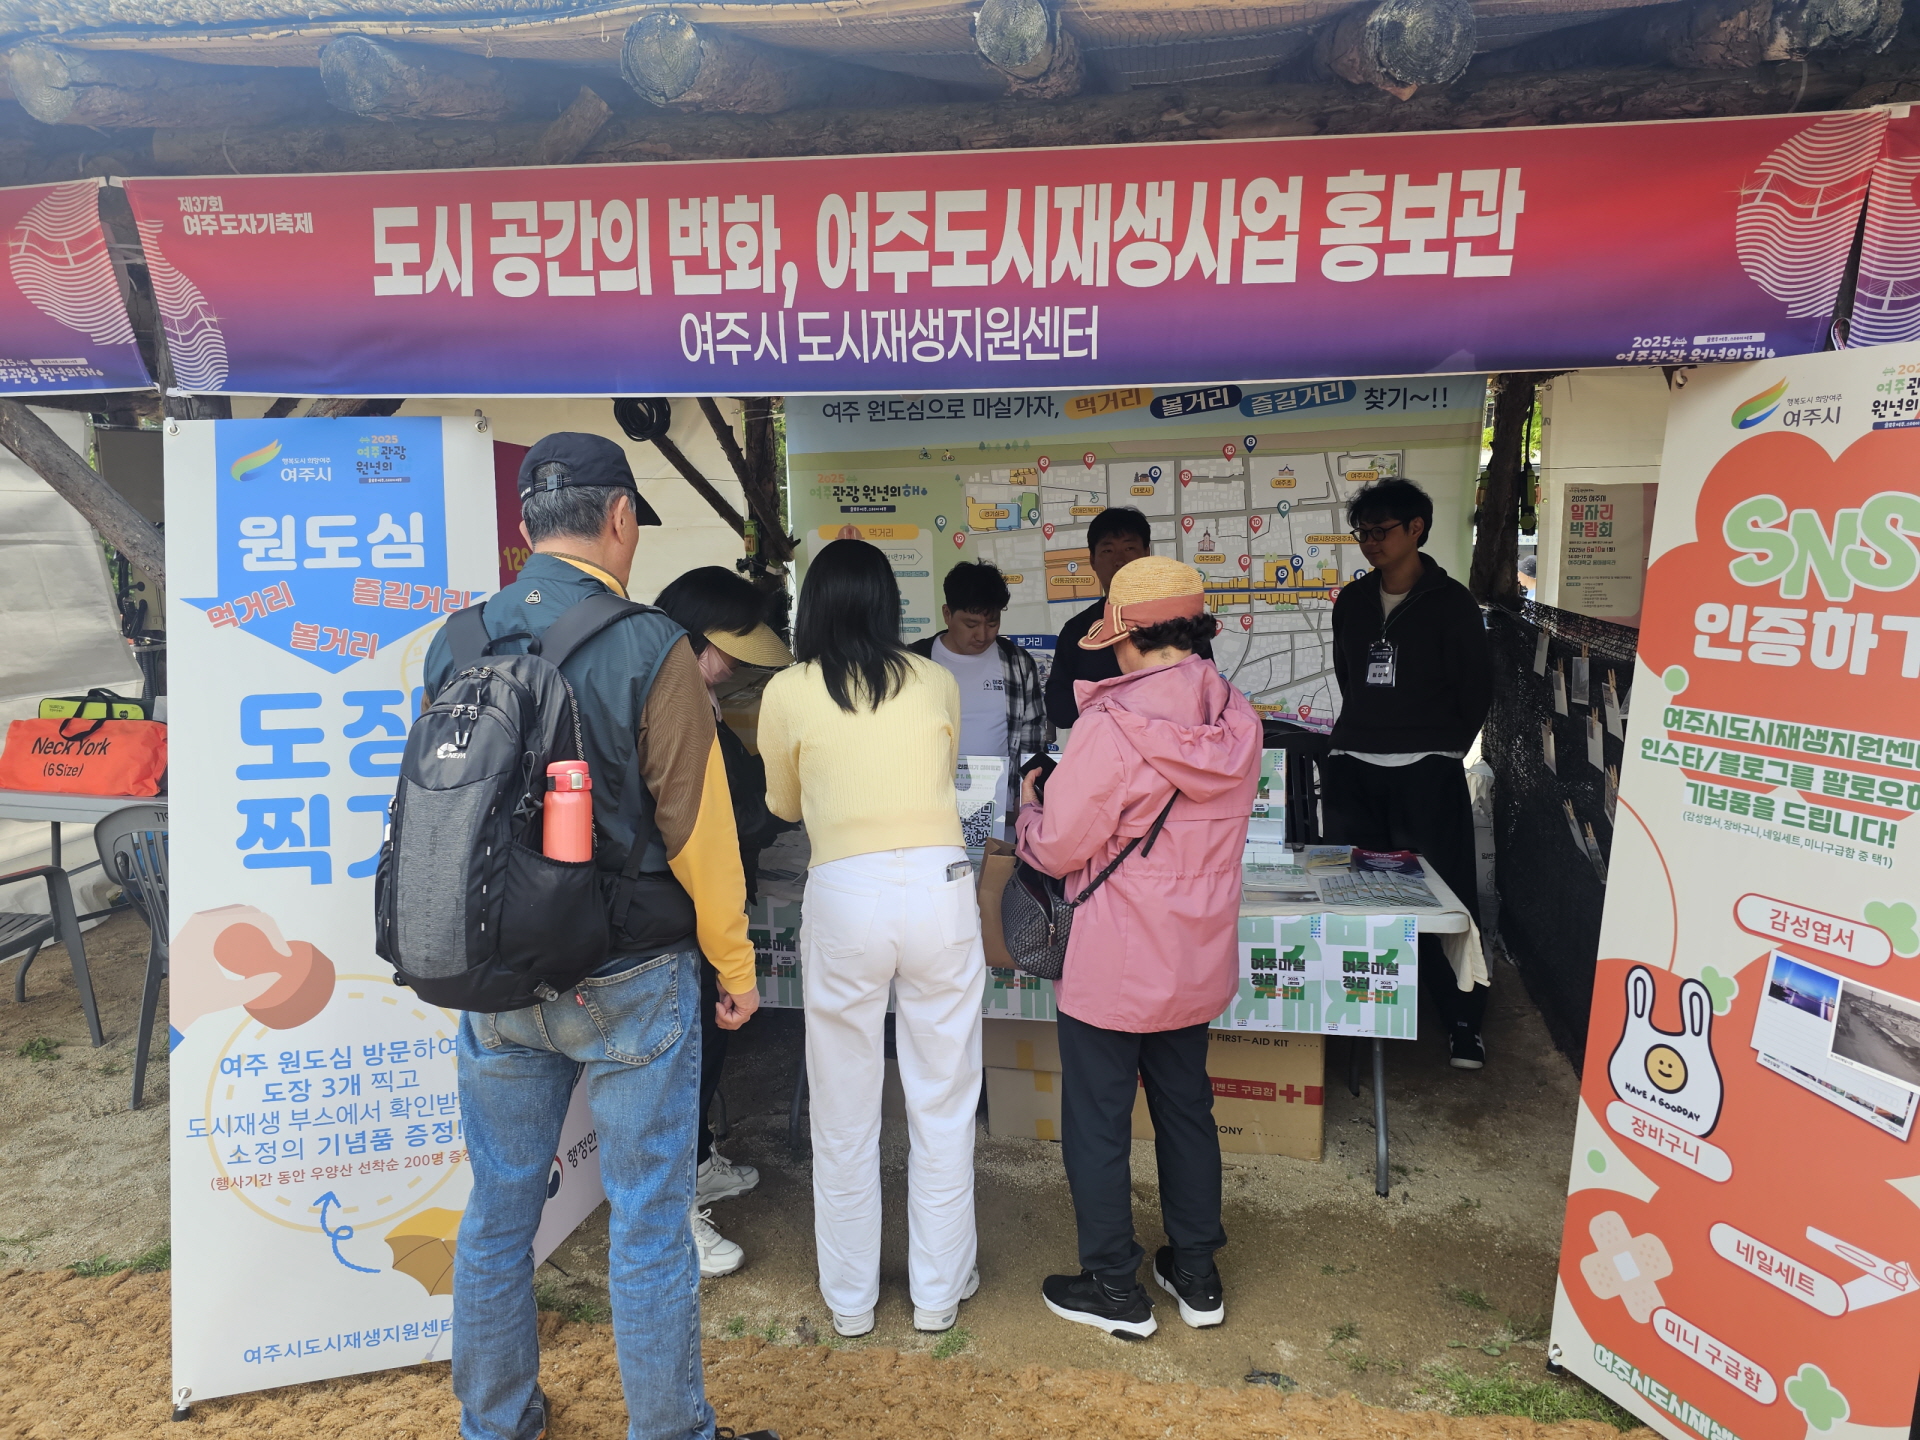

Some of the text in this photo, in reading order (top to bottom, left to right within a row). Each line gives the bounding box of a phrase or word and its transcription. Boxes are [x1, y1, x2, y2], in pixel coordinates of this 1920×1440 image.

[178, 196, 223, 213] 제37회
[183, 212, 313, 236] 여주도자기축제
[373, 167, 1525, 308] 도시 공간의 변화, 여주도시재생사업 홍보관
[680, 305, 1099, 365] 여주시 도시재생지원센터
[1632, 336, 1671, 348] 2025
[1616, 350, 1687, 363] 여주관광
[822, 402, 861, 423] 여주
[867, 398, 966, 422] 원도심으로
[973, 395, 1059, 420] 마실가자,
[1074, 387, 1141, 415] 먹거리
[1161, 386, 1230, 418] 볼거리
[1251, 381, 1346, 415] 즐길거리
[1782, 406, 1842, 427] 여주시
[371, 435, 398, 444] 2025
[356, 446, 407, 460] 여주관광
[280, 467, 332, 482] 여주시
[817, 474, 846, 483] 2025
[810, 485, 860, 503] 여주관광
[1571, 495, 1588, 503] 2025
[1571, 504, 1613, 520] 일자리
[869, 528, 894, 538] 먹거리
[1570, 522, 1613, 537] 박람회
[238, 512, 425, 571] 원도심
[1722, 491, 1920, 602] SNS
[206, 581, 296, 629] 먹거리
[353, 577, 472, 614] 즐길거리
[290, 621, 379, 660] 볼거리
[1017, 637, 1043, 647] 볼거리
[31, 737, 111, 756] Neck York
[1685, 782, 1898, 850] 기념품을 드립니다!
[1858, 849, 1869, 862] 중
[1871, 852, 1894, 869] 택1)
[1769, 907, 1855, 953] 감성엽서
[1251, 958, 1306, 972] 여주마실
[1342, 961, 1399, 976] 여주마실
[1251, 973, 1278, 987] 장터
[1342, 976, 1370, 990] 장터
[1274, 1039, 1290, 1047] KIT
[220, 1034, 459, 1078] 여주 원도심 방문하여
[262, 1069, 420, 1103] 도장 3개 찍고
[1241, 1085, 1275, 1097] 구급함
[1625, 1082, 1647, 1099] HAVE
[1650, 1094, 1657, 1103] A
[186, 1110, 281, 1138] 도시재생
[288, 1099, 381, 1132] 부스에서
[1217, 1125, 1243, 1136] ONY
[1631, 1115, 1700, 1165] 장바구니
[227, 1119, 463, 1165] 소정의 기념품 증정!
[210, 1169, 273, 1192] (행사기간
[277, 1168, 306, 1185] 동안
[310, 1163, 353, 1181] 우양산
[358, 1157, 399, 1175] 선착순
[404, 1151, 444, 1169] 200명
[1736, 1238, 1816, 1298] 네일세트
[1664, 1317, 1763, 1394] 미니 구급함
